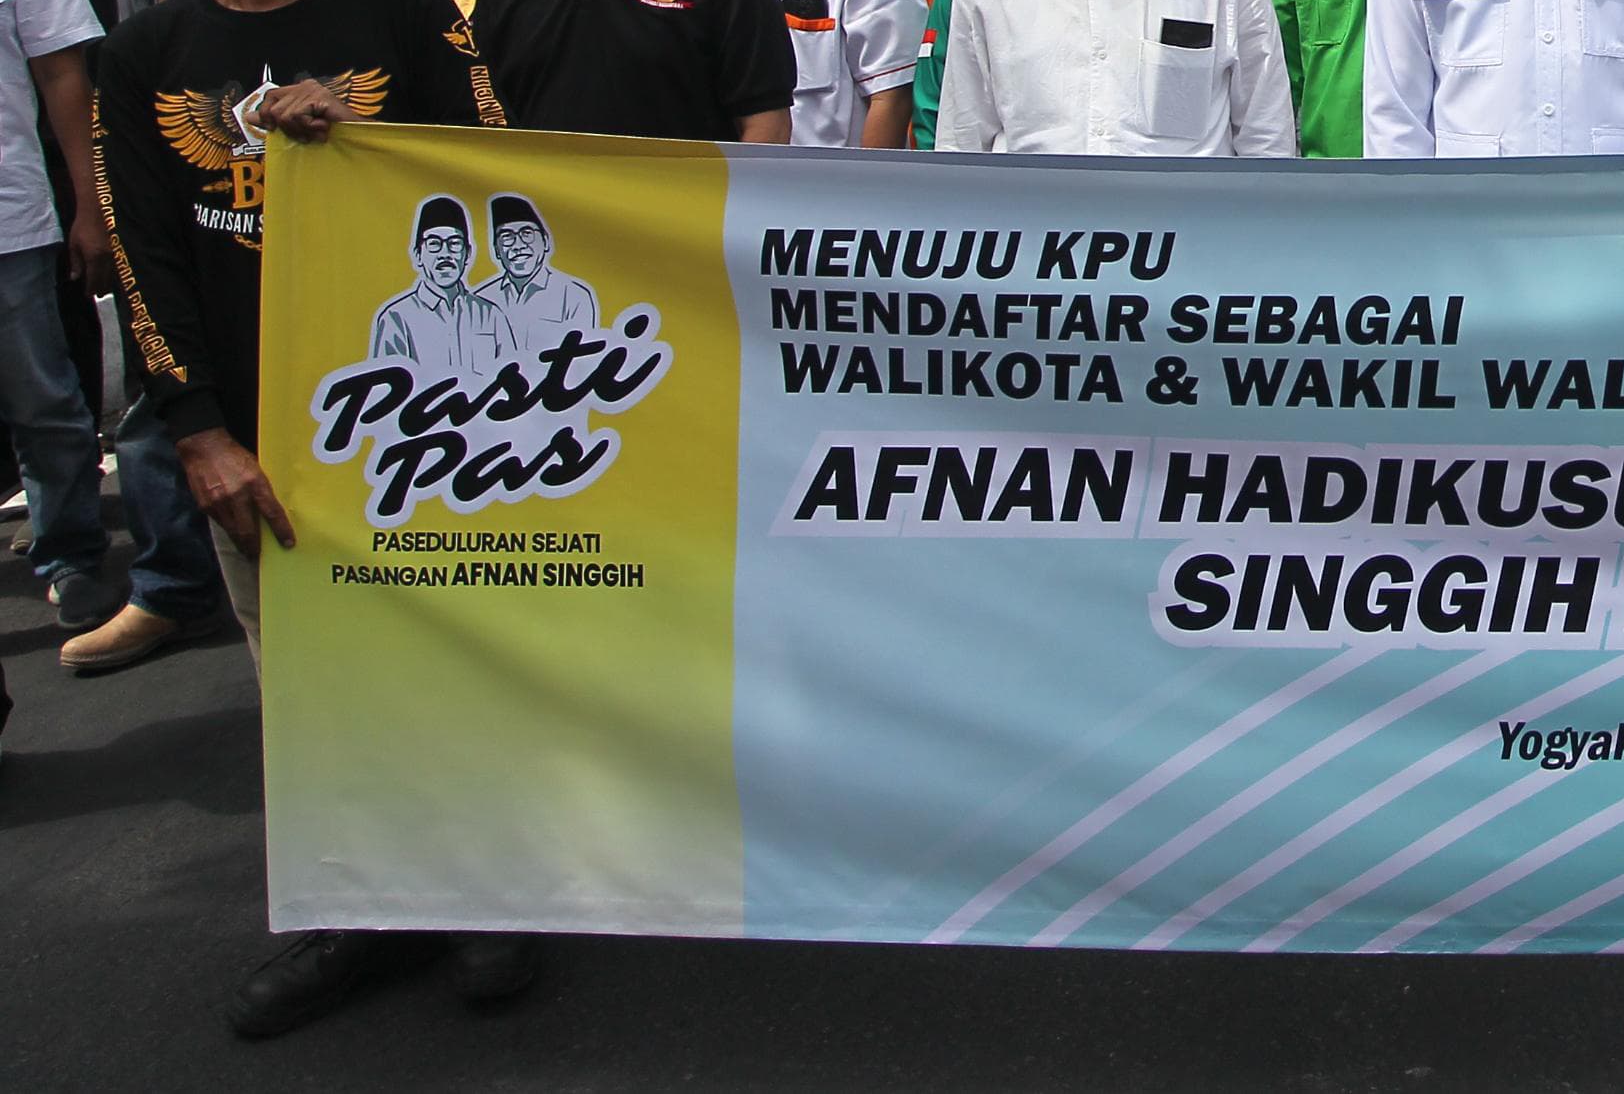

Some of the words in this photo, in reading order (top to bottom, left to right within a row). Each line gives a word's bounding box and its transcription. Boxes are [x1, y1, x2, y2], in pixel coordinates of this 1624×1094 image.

[761, 229, 1021, 280] MENUJU
[1037, 232, 1175, 281] KPU
[771, 288, 1149, 343] MENDAFTAR
[1166, 295, 1464, 346] SEBAGAI
[323, 314, 662, 452] Pasti
[780, 343, 1123, 402] WALIKOTA
[1146, 356, 1198, 405] &
[1222, 357, 1456, 409] WAKIL
[376, 426, 609, 516] Pas
[794, 447, 1134, 522] AFNAN
[332, 564, 448, 587] PASANGAN
[451, 562, 538, 587] AFNAN
[543, 562, 644, 588] SINGGIH
[372, 532, 526, 553] PASEDULURAN
[531, 532, 601, 554] SEJATI
[1165, 554, 1600, 633] SINGGIH
